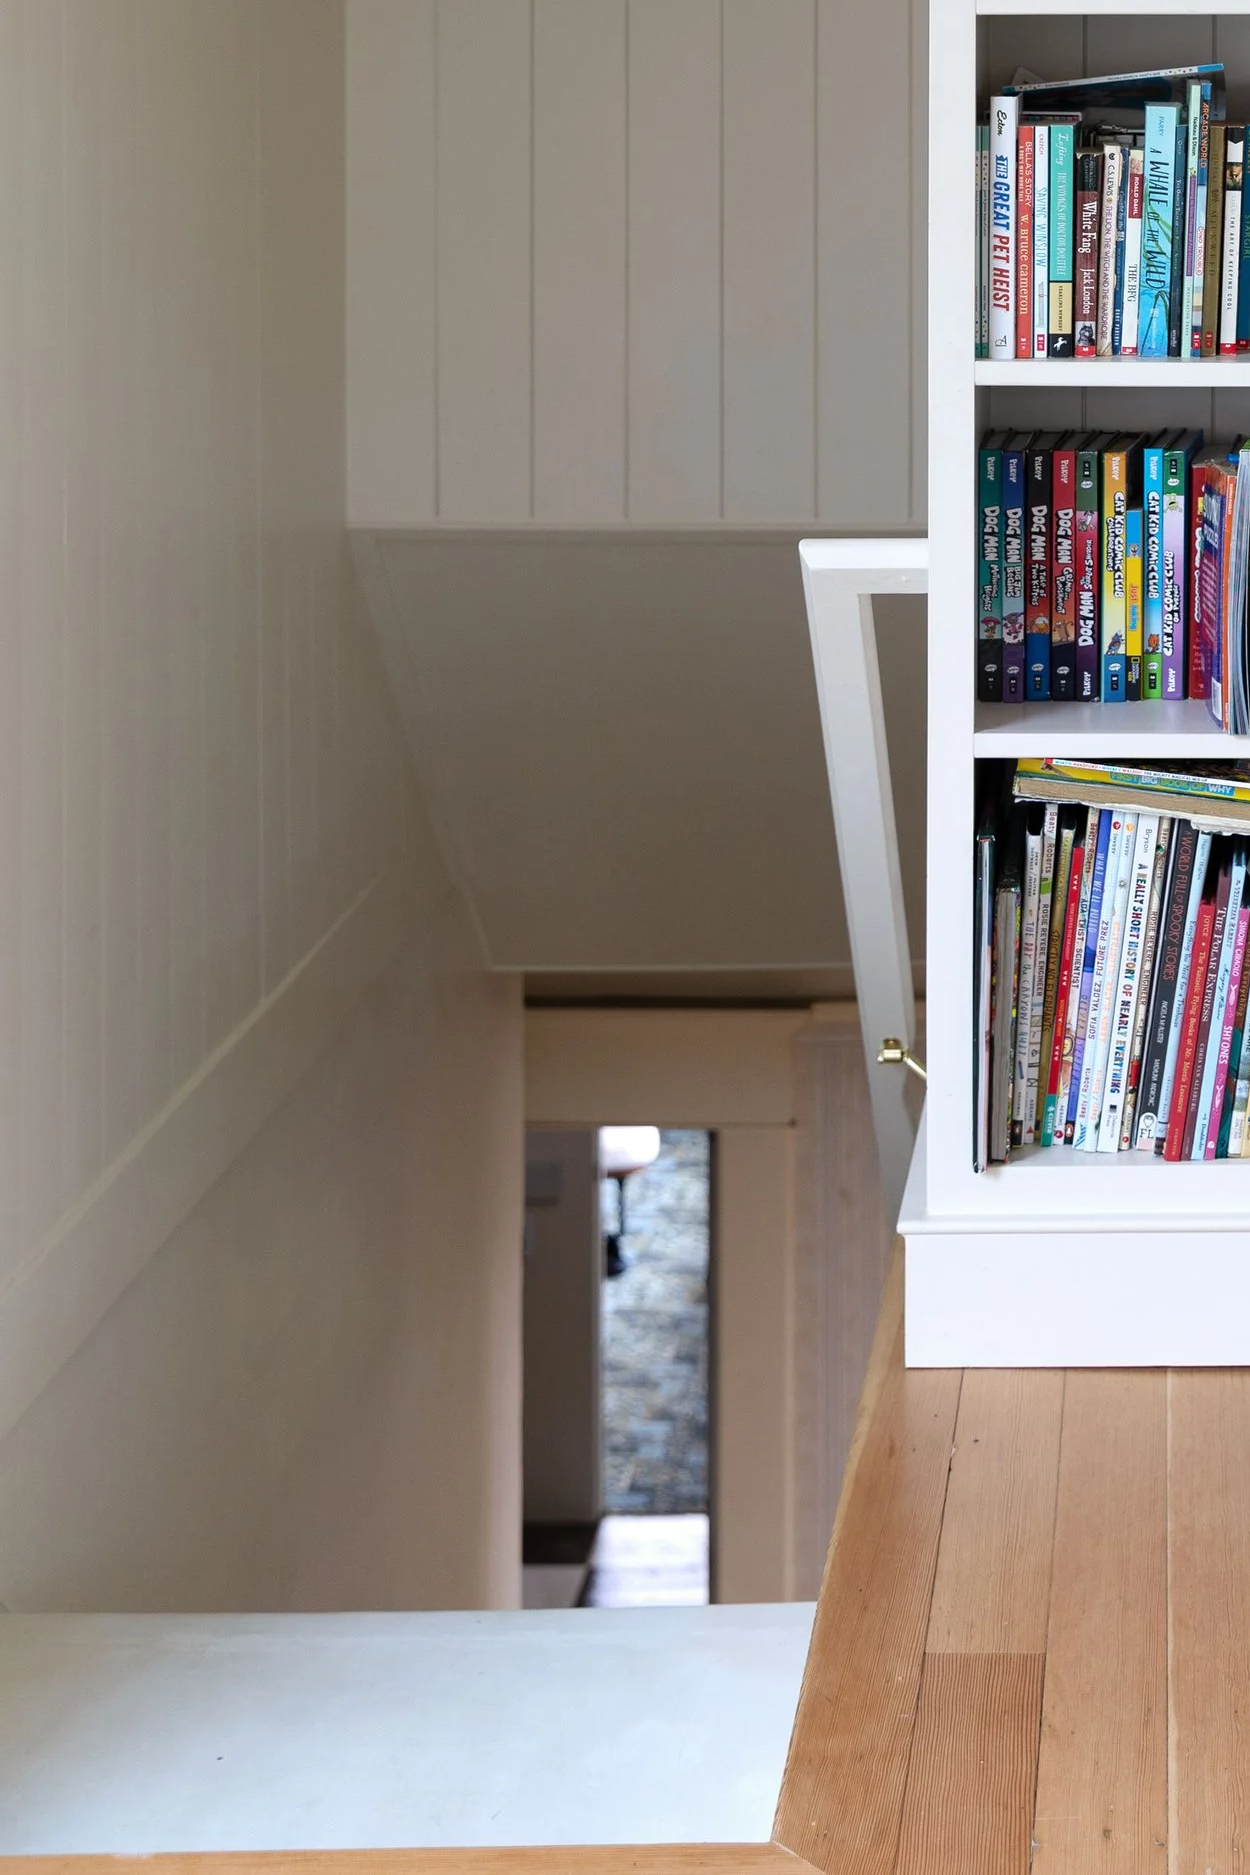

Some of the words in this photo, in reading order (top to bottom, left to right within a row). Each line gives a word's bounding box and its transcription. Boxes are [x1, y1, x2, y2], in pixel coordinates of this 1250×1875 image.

[1149, 147, 1161, 155] A
[995, 155, 1009, 179] THE
[1148, 160, 1170, 207] WHALE
[993, 181, 1010, 231] GREAT
[1082, 200, 1097, 230] White
[1148, 211, 1160, 221] OF
[993, 233, 1010, 263] PET
[1079, 232, 1097, 254] Fang
[1147, 226, 1160, 244] THE
[1080, 268, 1095, 285] Jack
[1128, 264, 1137, 282] THE
[1146, 248, 1166, 290] WILD
[992, 266, 1010, 311] HEIST
[1082, 286, 1094, 314] London
[1127, 284, 1137, 302] BFG
[1006, 507, 1022, 535] DOG
[1006, 536, 1022, 563] MAN
[1207, 783, 1233, 795] WHY
[1133, 873, 1146, 904] REALLY
[1129, 906, 1142, 938] SHORT
[1214, 907, 1228, 929] THE
[1124, 941, 1139, 980] HISTORY
[1208, 931, 1224, 968] POLAR
[1123, 984, 1133, 996] OF
[1201, 970, 1218, 1022] EXPRESS
[1117, 1000, 1131, 1035] NEARLY
[1109, 1039, 1127, 1093] EVERYTHING
